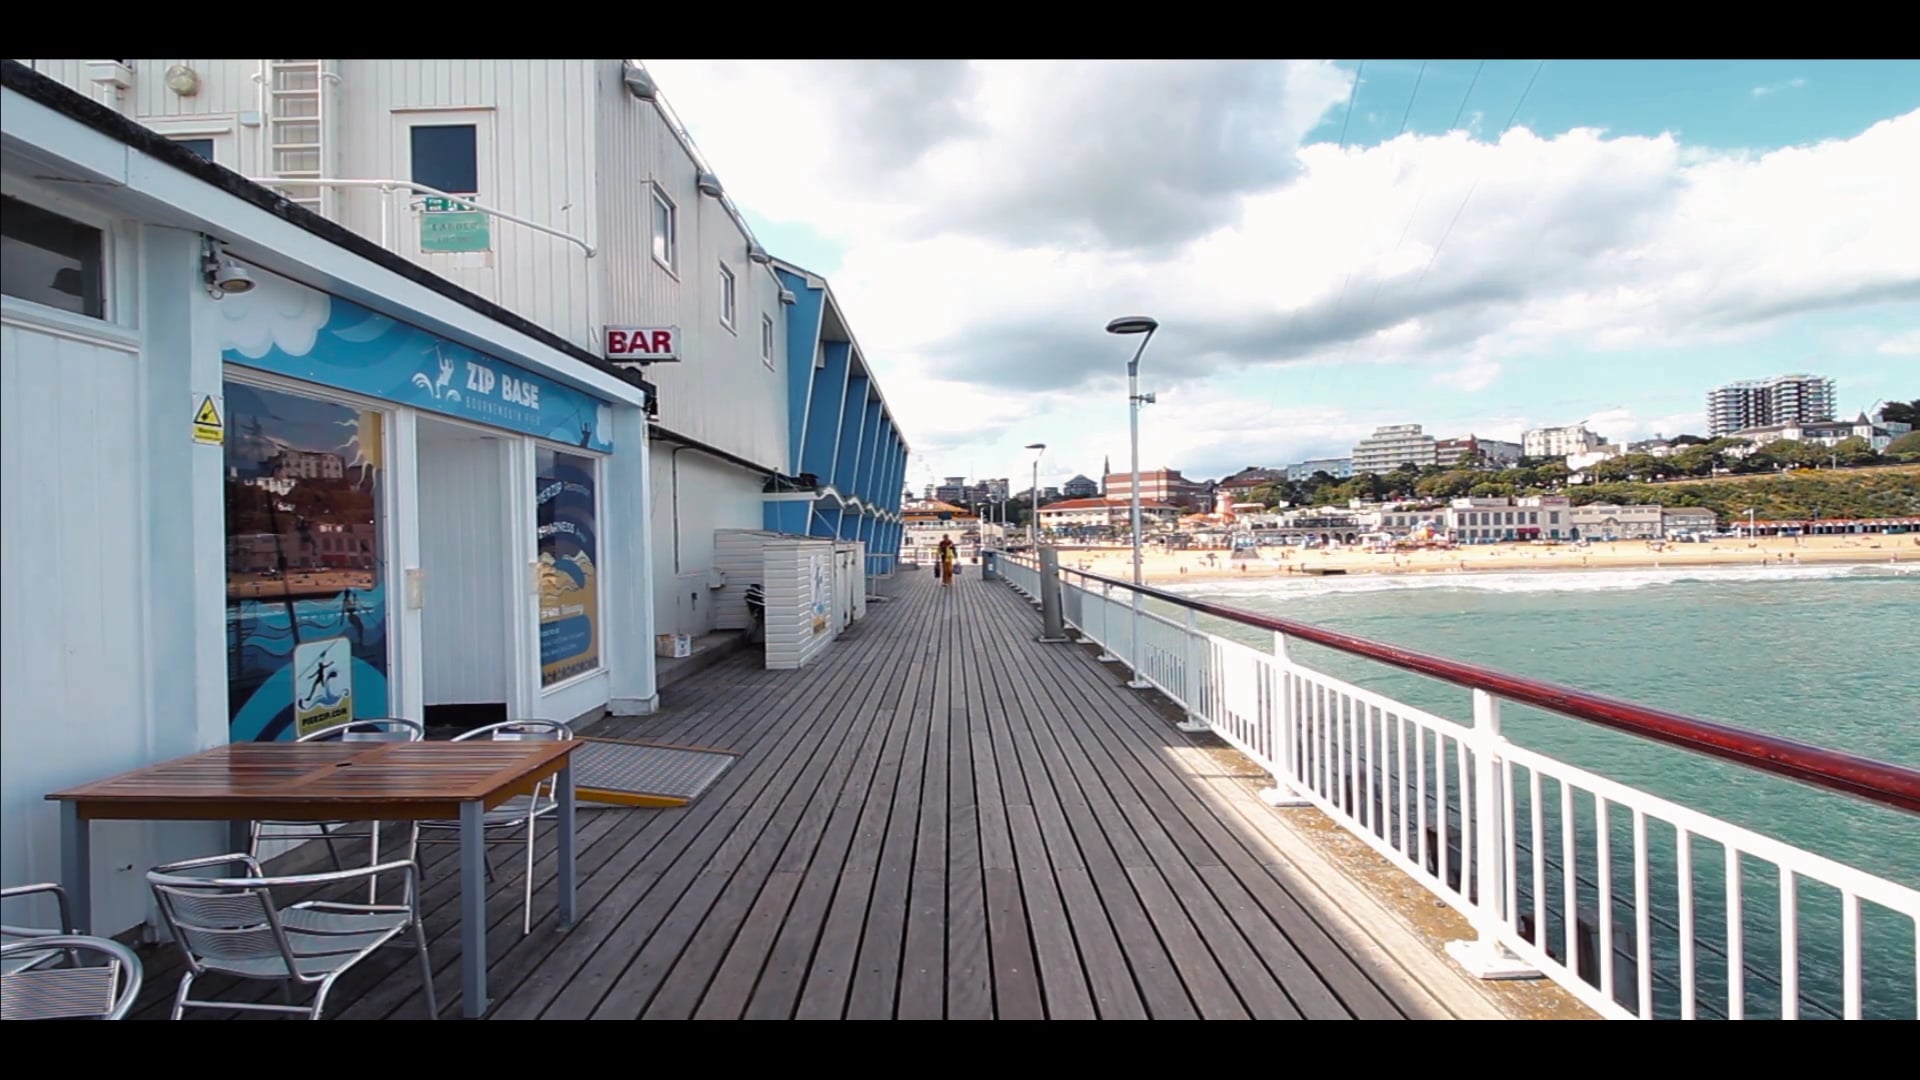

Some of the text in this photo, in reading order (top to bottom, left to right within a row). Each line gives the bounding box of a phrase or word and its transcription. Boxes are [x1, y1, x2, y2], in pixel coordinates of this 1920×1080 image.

[607, 331, 672, 354] BAR
[466, 361, 540, 410] ZIP BASE
[466, 396, 522, 420] BOURNEMOUTH
